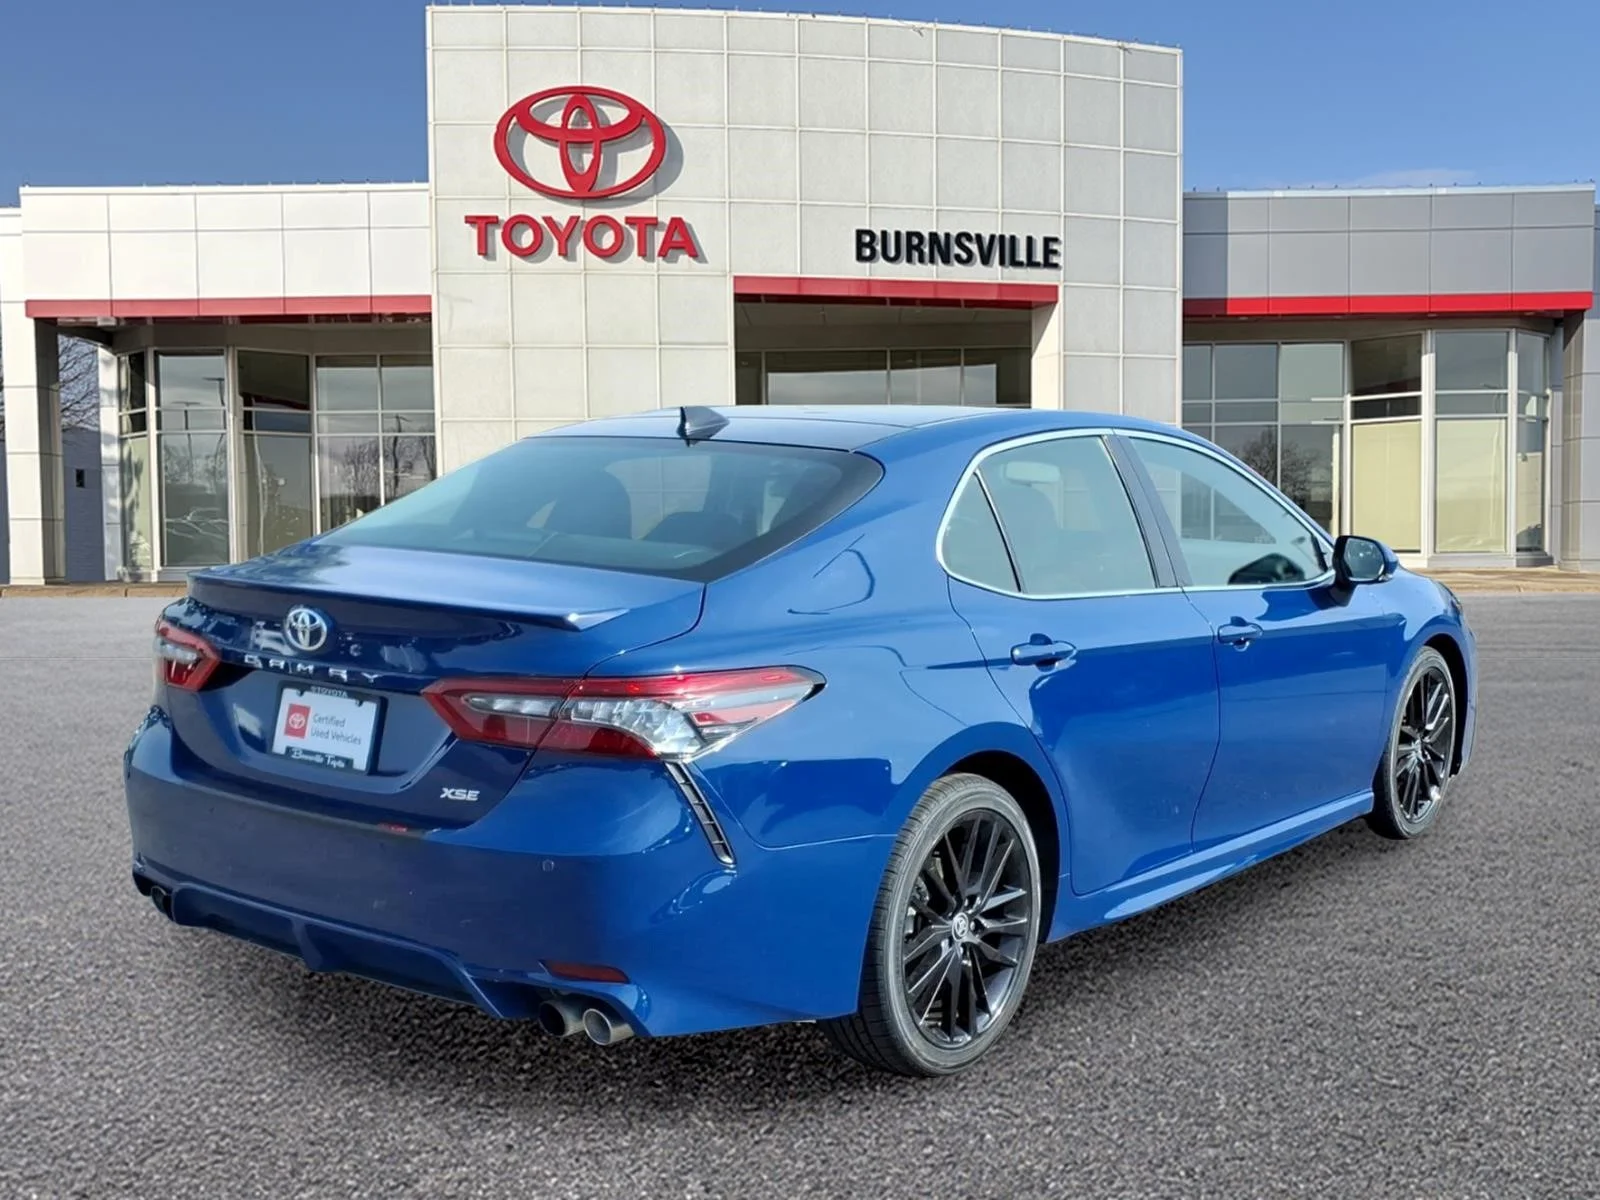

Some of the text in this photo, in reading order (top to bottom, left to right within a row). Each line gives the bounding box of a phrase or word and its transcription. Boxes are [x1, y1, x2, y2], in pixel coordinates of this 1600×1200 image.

[464, 214, 699, 258] TOYOTA
[855, 229, 1060, 269] BURNSVILLE
[314, 686, 348, 698] TOYOTA
[313, 713, 346, 728] Certified
[310, 728, 362, 745] Used Vehicles
[440, 787, 480, 801] XSE
